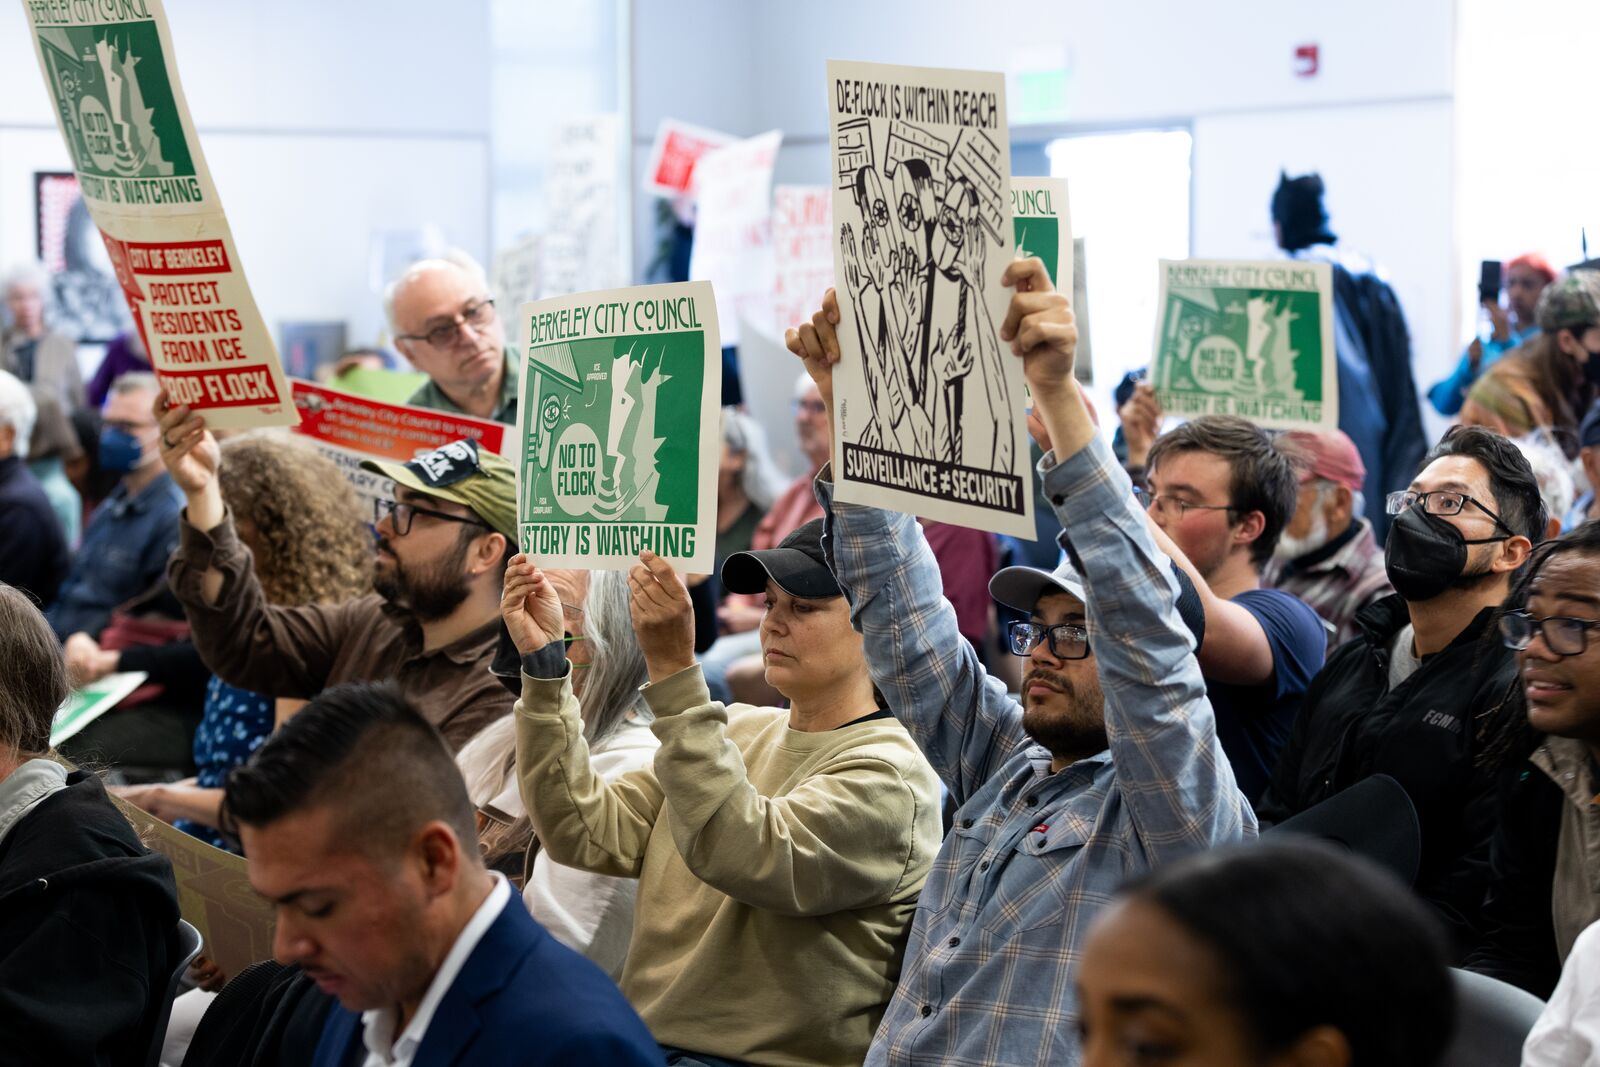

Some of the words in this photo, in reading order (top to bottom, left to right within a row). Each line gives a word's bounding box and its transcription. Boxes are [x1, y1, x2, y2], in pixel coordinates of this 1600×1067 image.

[836, 79, 888, 118] DE-FLOCK
[889, 84, 901, 121] IS
[903, 85, 949, 125] WITHIN
[953, 90, 998, 129] REACH
[110, 179, 121, 204] IS
[121, 177, 204, 205] WATCHING
[1011, 189, 1057, 216] UNCIL
[128, 247, 149, 269] CITY
[150, 248, 164, 269] OF
[163, 246, 225, 269] BERKELEY
[148, 281, 221, 306] PROTECT
[150, 309, 242, 336] RESIDENTS
[530, 306, 591, 344] BERKELEY
[594, 302, 630, 334] CITY
[633, 297, 702, 332] COUNCIL
[160, 340, 210, 364] FROM
[211, 337, 247, 361] ICE
[165, 375, 203, 404] ROP
[203, 370, 276, 402] FLOCK
[1236, 400, 1322, 424] WATCHING
[558, 443, 576, 469] NO
[578, 443, 596, 468] TO
[557, 470, 597, 496] FLOCK
[846, 447, 938, 494] SURVEILLANCE
[951, 468, 1018, 510] SECURITY
[521, 526, 571, 555] STORY
[575, 526, 590, 555] IS
[596, 525, 696, 558] WATCHING
